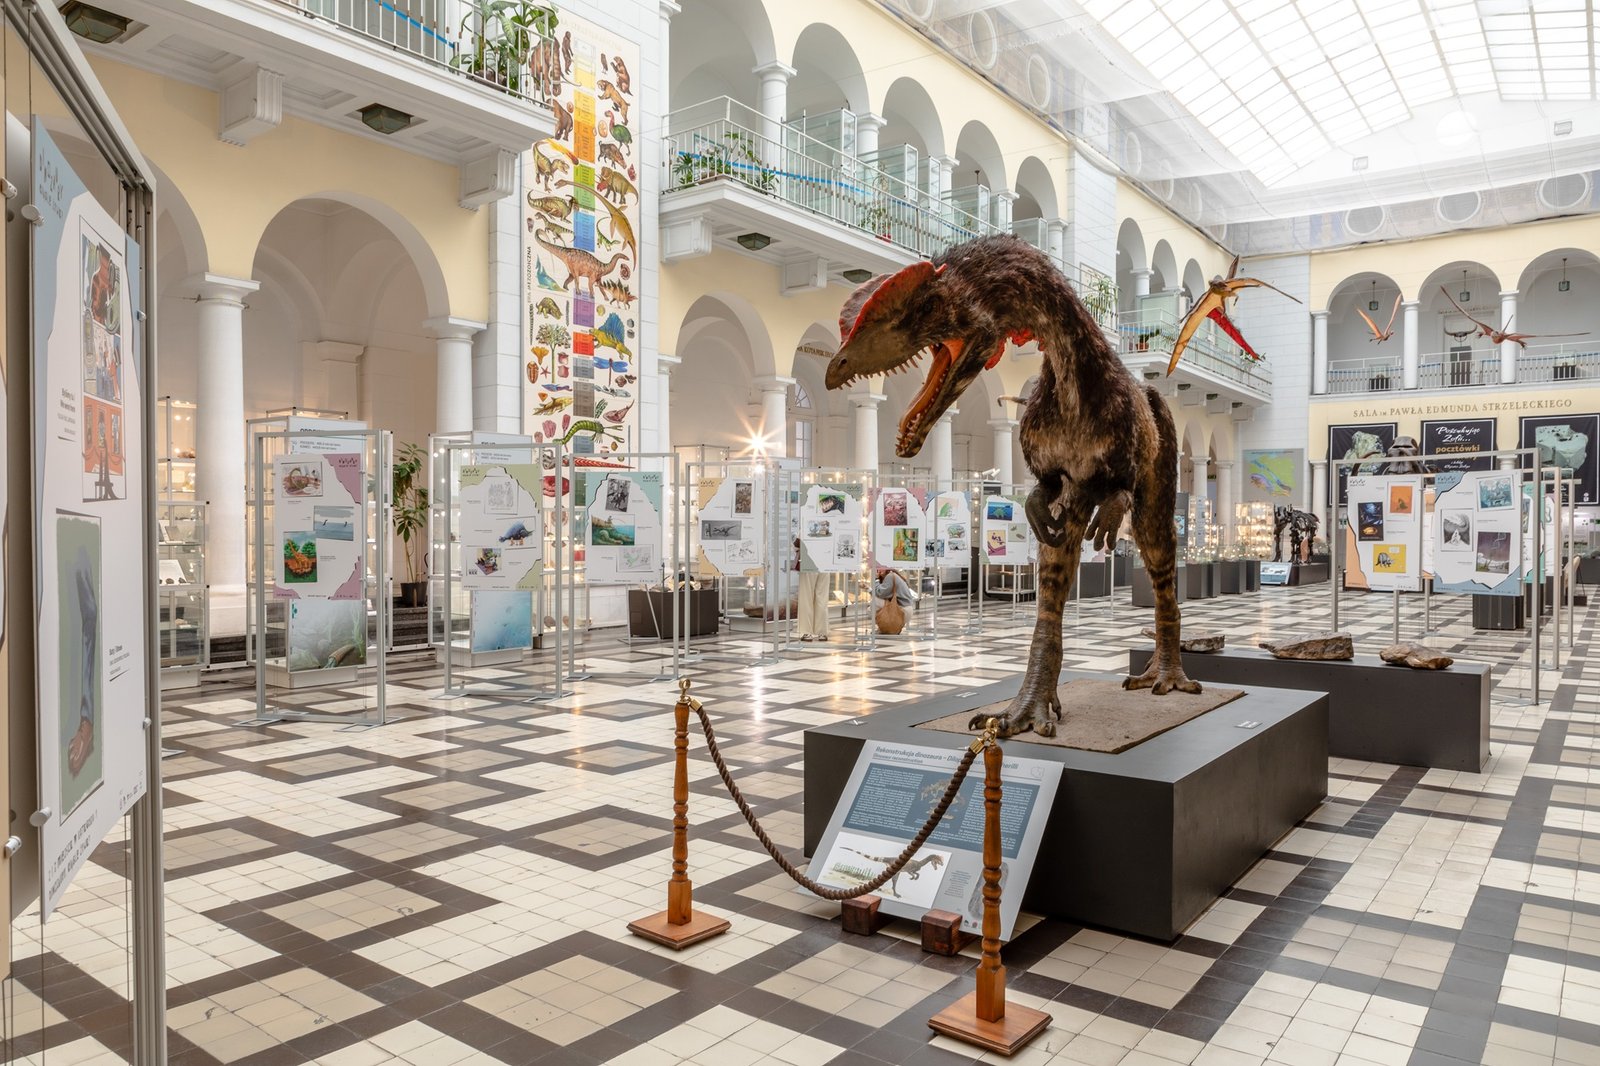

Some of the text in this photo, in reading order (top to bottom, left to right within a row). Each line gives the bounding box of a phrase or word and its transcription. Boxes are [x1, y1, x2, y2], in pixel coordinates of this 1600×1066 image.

[1353, 409, 1378, 418] SALA
[1390, 406, 1423, 416] PAWŁA
[1426, 403, 1478, 414] EDMUNDA
[1482, 398, 1573, 411] STRZELECKIEGO
[1435, 444, 1480, 454] pocztówki
[915, 750, 942, 761] dinozaura
